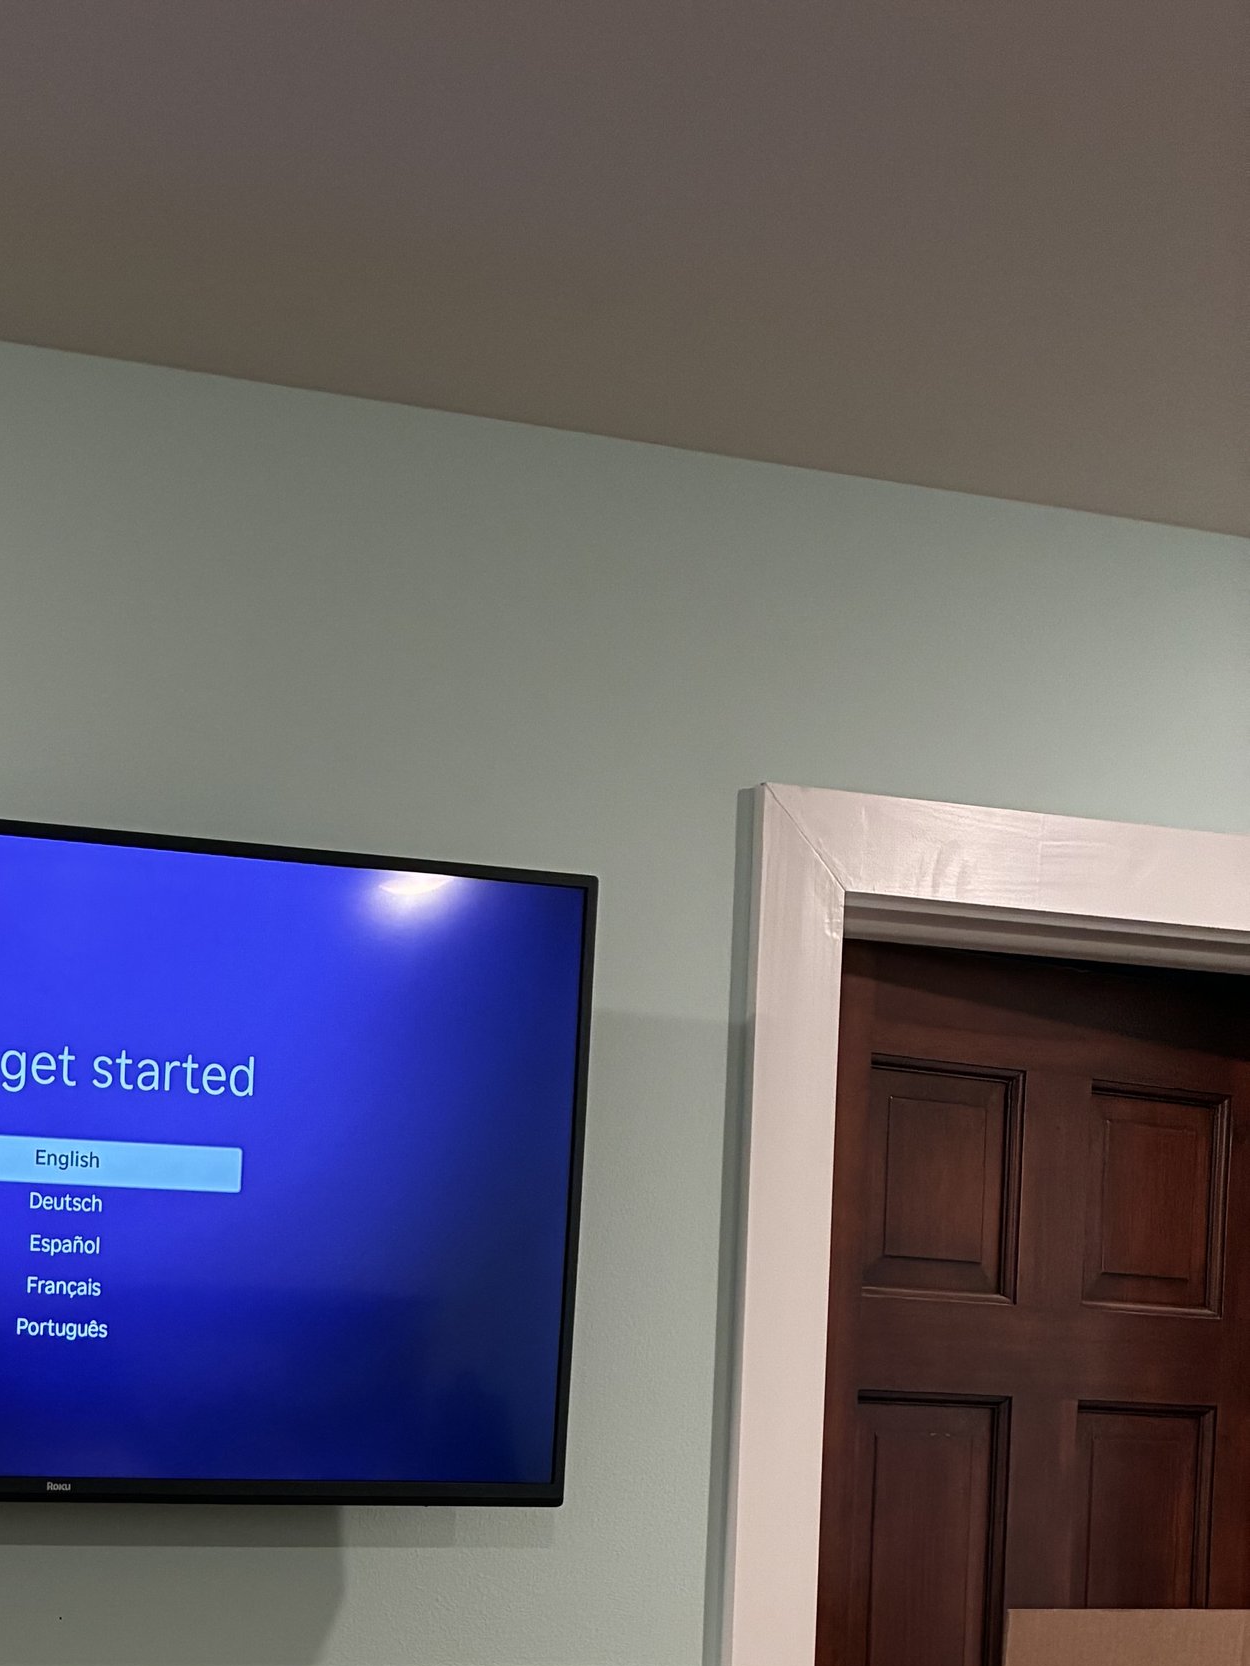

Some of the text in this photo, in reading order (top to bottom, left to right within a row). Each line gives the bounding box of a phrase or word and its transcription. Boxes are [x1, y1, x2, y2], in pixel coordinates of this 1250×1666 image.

[0, 1045, 78, 1094] get
[90, 1048, 256, 1098] started
[34, 1148, 101, 1172] English
[28, 1191, 103, 1214] Deutsch
[28, 1232, 101, 1258] Español
[25, 1275, 102, 1300] Français
[15, 1316, 109, 1342] Português
